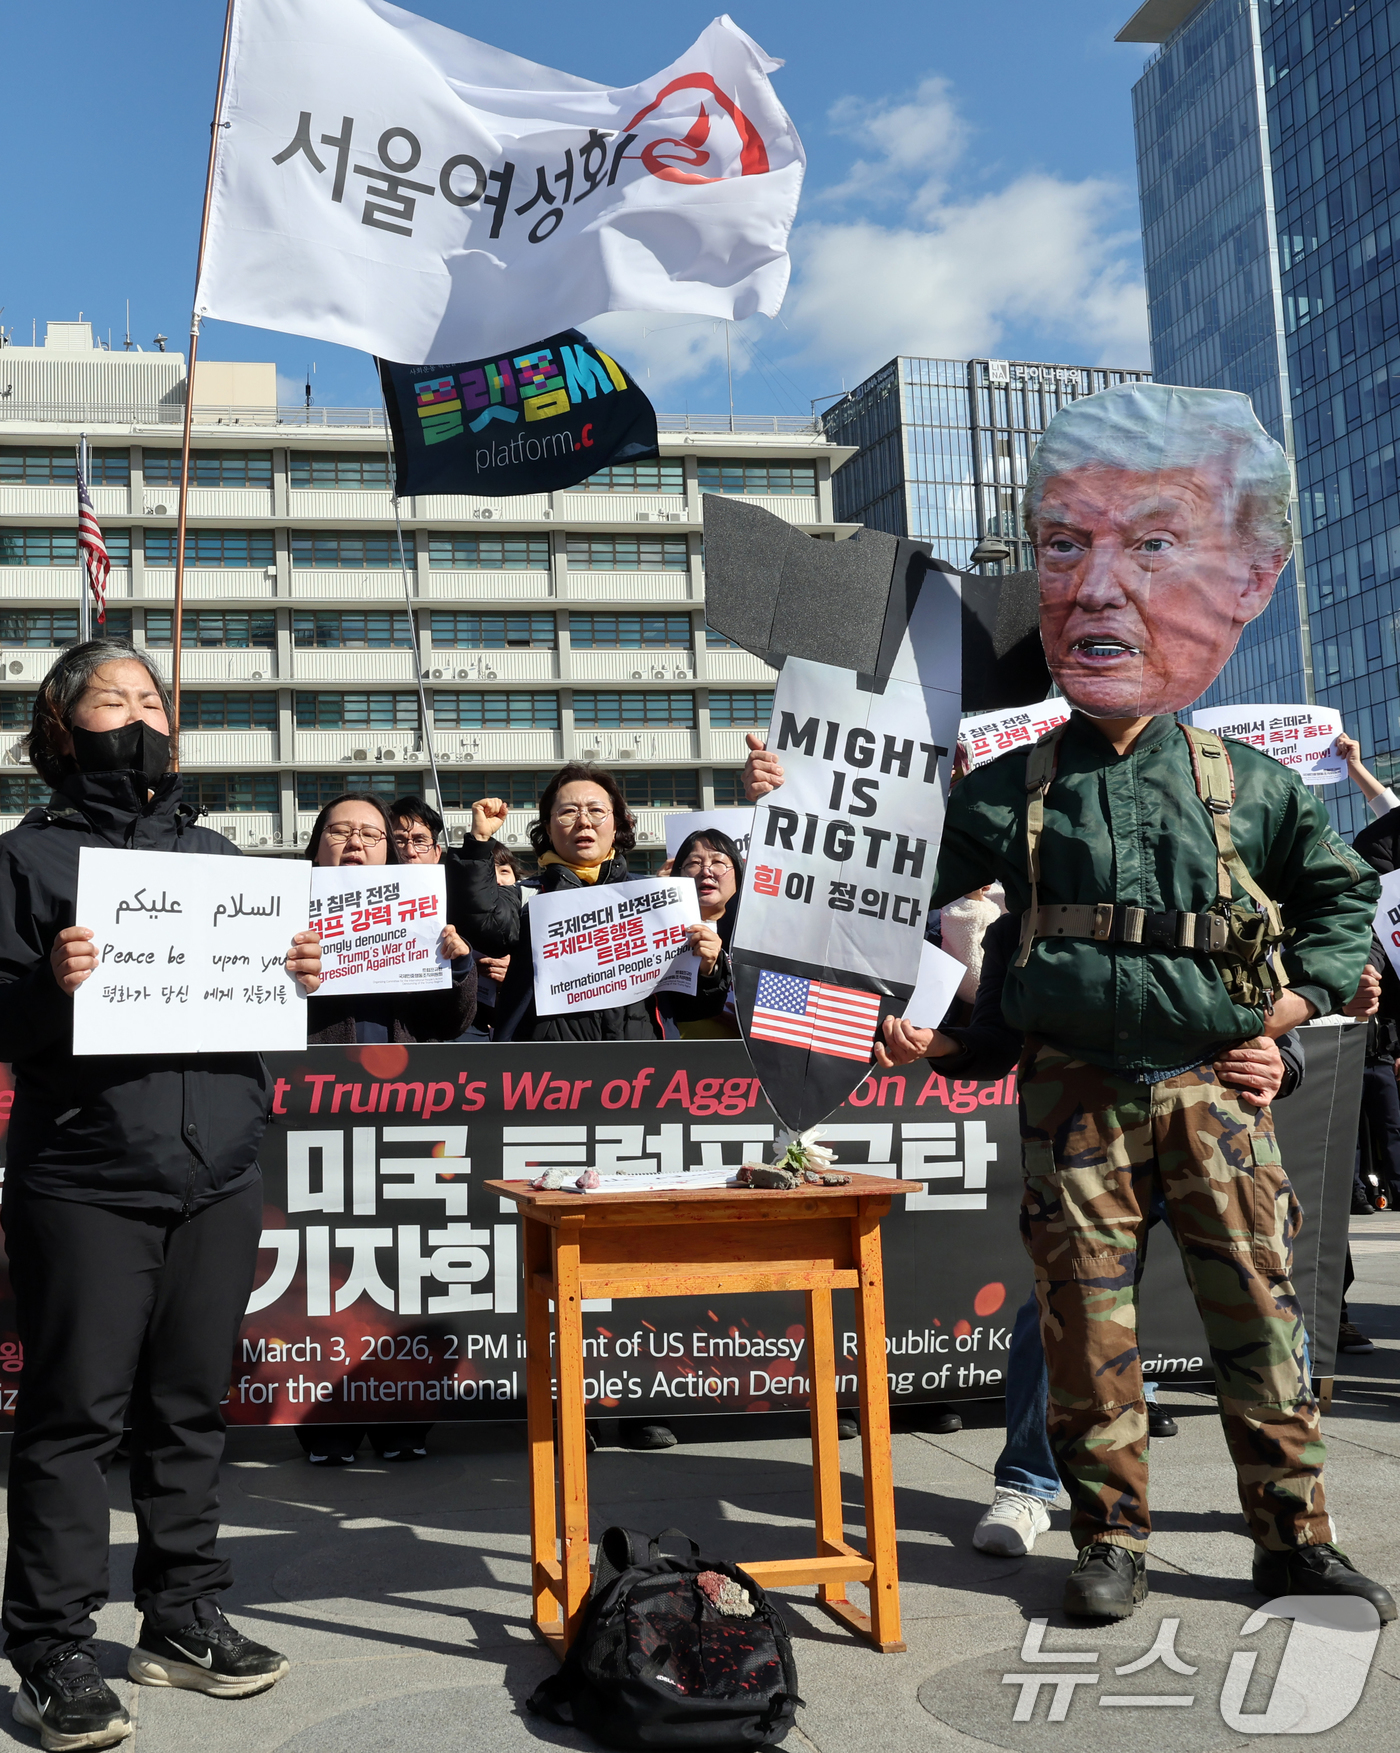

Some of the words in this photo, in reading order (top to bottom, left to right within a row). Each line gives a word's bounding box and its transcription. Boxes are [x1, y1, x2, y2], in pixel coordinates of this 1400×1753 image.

[272, 110, 639, 245] 서울여성회
[1015, 366, 1082, 385] 라이나타워
[475, 423, 594, 474] platform.c
[968, 723, 999, 739] 침략
[1000, 713, 1031, 730] 전쟁
[993, 726, 1031, 749] 강력
[1269, 713, 1313, 730] 손떼라
[1269, 729, 1300, 743] 즉각
[1303, 724, 1333, 739] 중단
[777, 710, 949, 785] MIGHT
[1273, 743, 1297, 756] Iran!
[1277, 755, 1303, 766] acks
[1305, 748, 1331, 764] now!
[828, 770, 880, 818] IS
[764, 804, 927, 879] RIGTH
[115, 887, 183, 925] عليكم
[213, 893, 281, 927] السلام
[327, 890, 362, 914] 침략
[366, 882, 400, 906] 전쟁
[351, 903, 392, 933] 강력
[397, 895, 439, 923] 규탄
[547, 905, 614, 938] 국제연대
[617, 885, 683, 919] 반전평화
[753, 864, 815, 904] 힘이
[828, 881, 922, 928] 정의다
[337, 946, 379, 966] Trump's
[381, 943, 403, 956] War
[405, 938, 417, 951] of
[355, 927, 407, 948] denounce
[543, 916, 644, 959] 국제민중행동
[597, 935, 648, 966] 트럼프
[652, 924, 687, 949] 규탄
[101, 943, 156, 965] Peace
[167, 945, 186, 965] be
[212, 954, 250, 973] upon
[319, 964, 363, 983] gression
[366, 957, 405, 972] Against
[408, 948, 429, 963] Iran
[550, 966, 616, 995] International
[618, 953, 662, 976] People's
[102, 984, 151, 1003] 평화가
[161, 985, 189, 1004] 당신
[567, 979, 627, 1005] Denouncing
[629, 968, 661, 986] Trump
[304, 1071, 487, 1119] Trump's
[502, 1071, 592, 1110] War
[601, 1067, 655, 1109] of
[916, 1064, 1019, 1113] Agai
[286, 1125, 472, 1216] 미국
[244, 1222, 613, 1317] 기자회
[242, 1335, 322, 1362] March
[329, 1335, 352, 1366] 3,
[360, 1334, 433, 1364] 2026,
[443, 1334, 459, 1359] 2
[466, 1333, 509, 1359] PM
[615, 1331, 643, 1358] of
[650, 1332, 685, 1357] US
[692, 1331, 805, 1361] Embassy
[843, 1328, 949, 1356] Rublic
[955, 1326, 980, 1351] of
[238, 1376, 279, 1404] for
[286, 1374, 333, 1403] the
[343, 1371, 518, 1403] International
[649, 1370, 739, 1398] Action
[921, 1363, 952, 1389] of
[957, 1363, 1000, 1388] the
